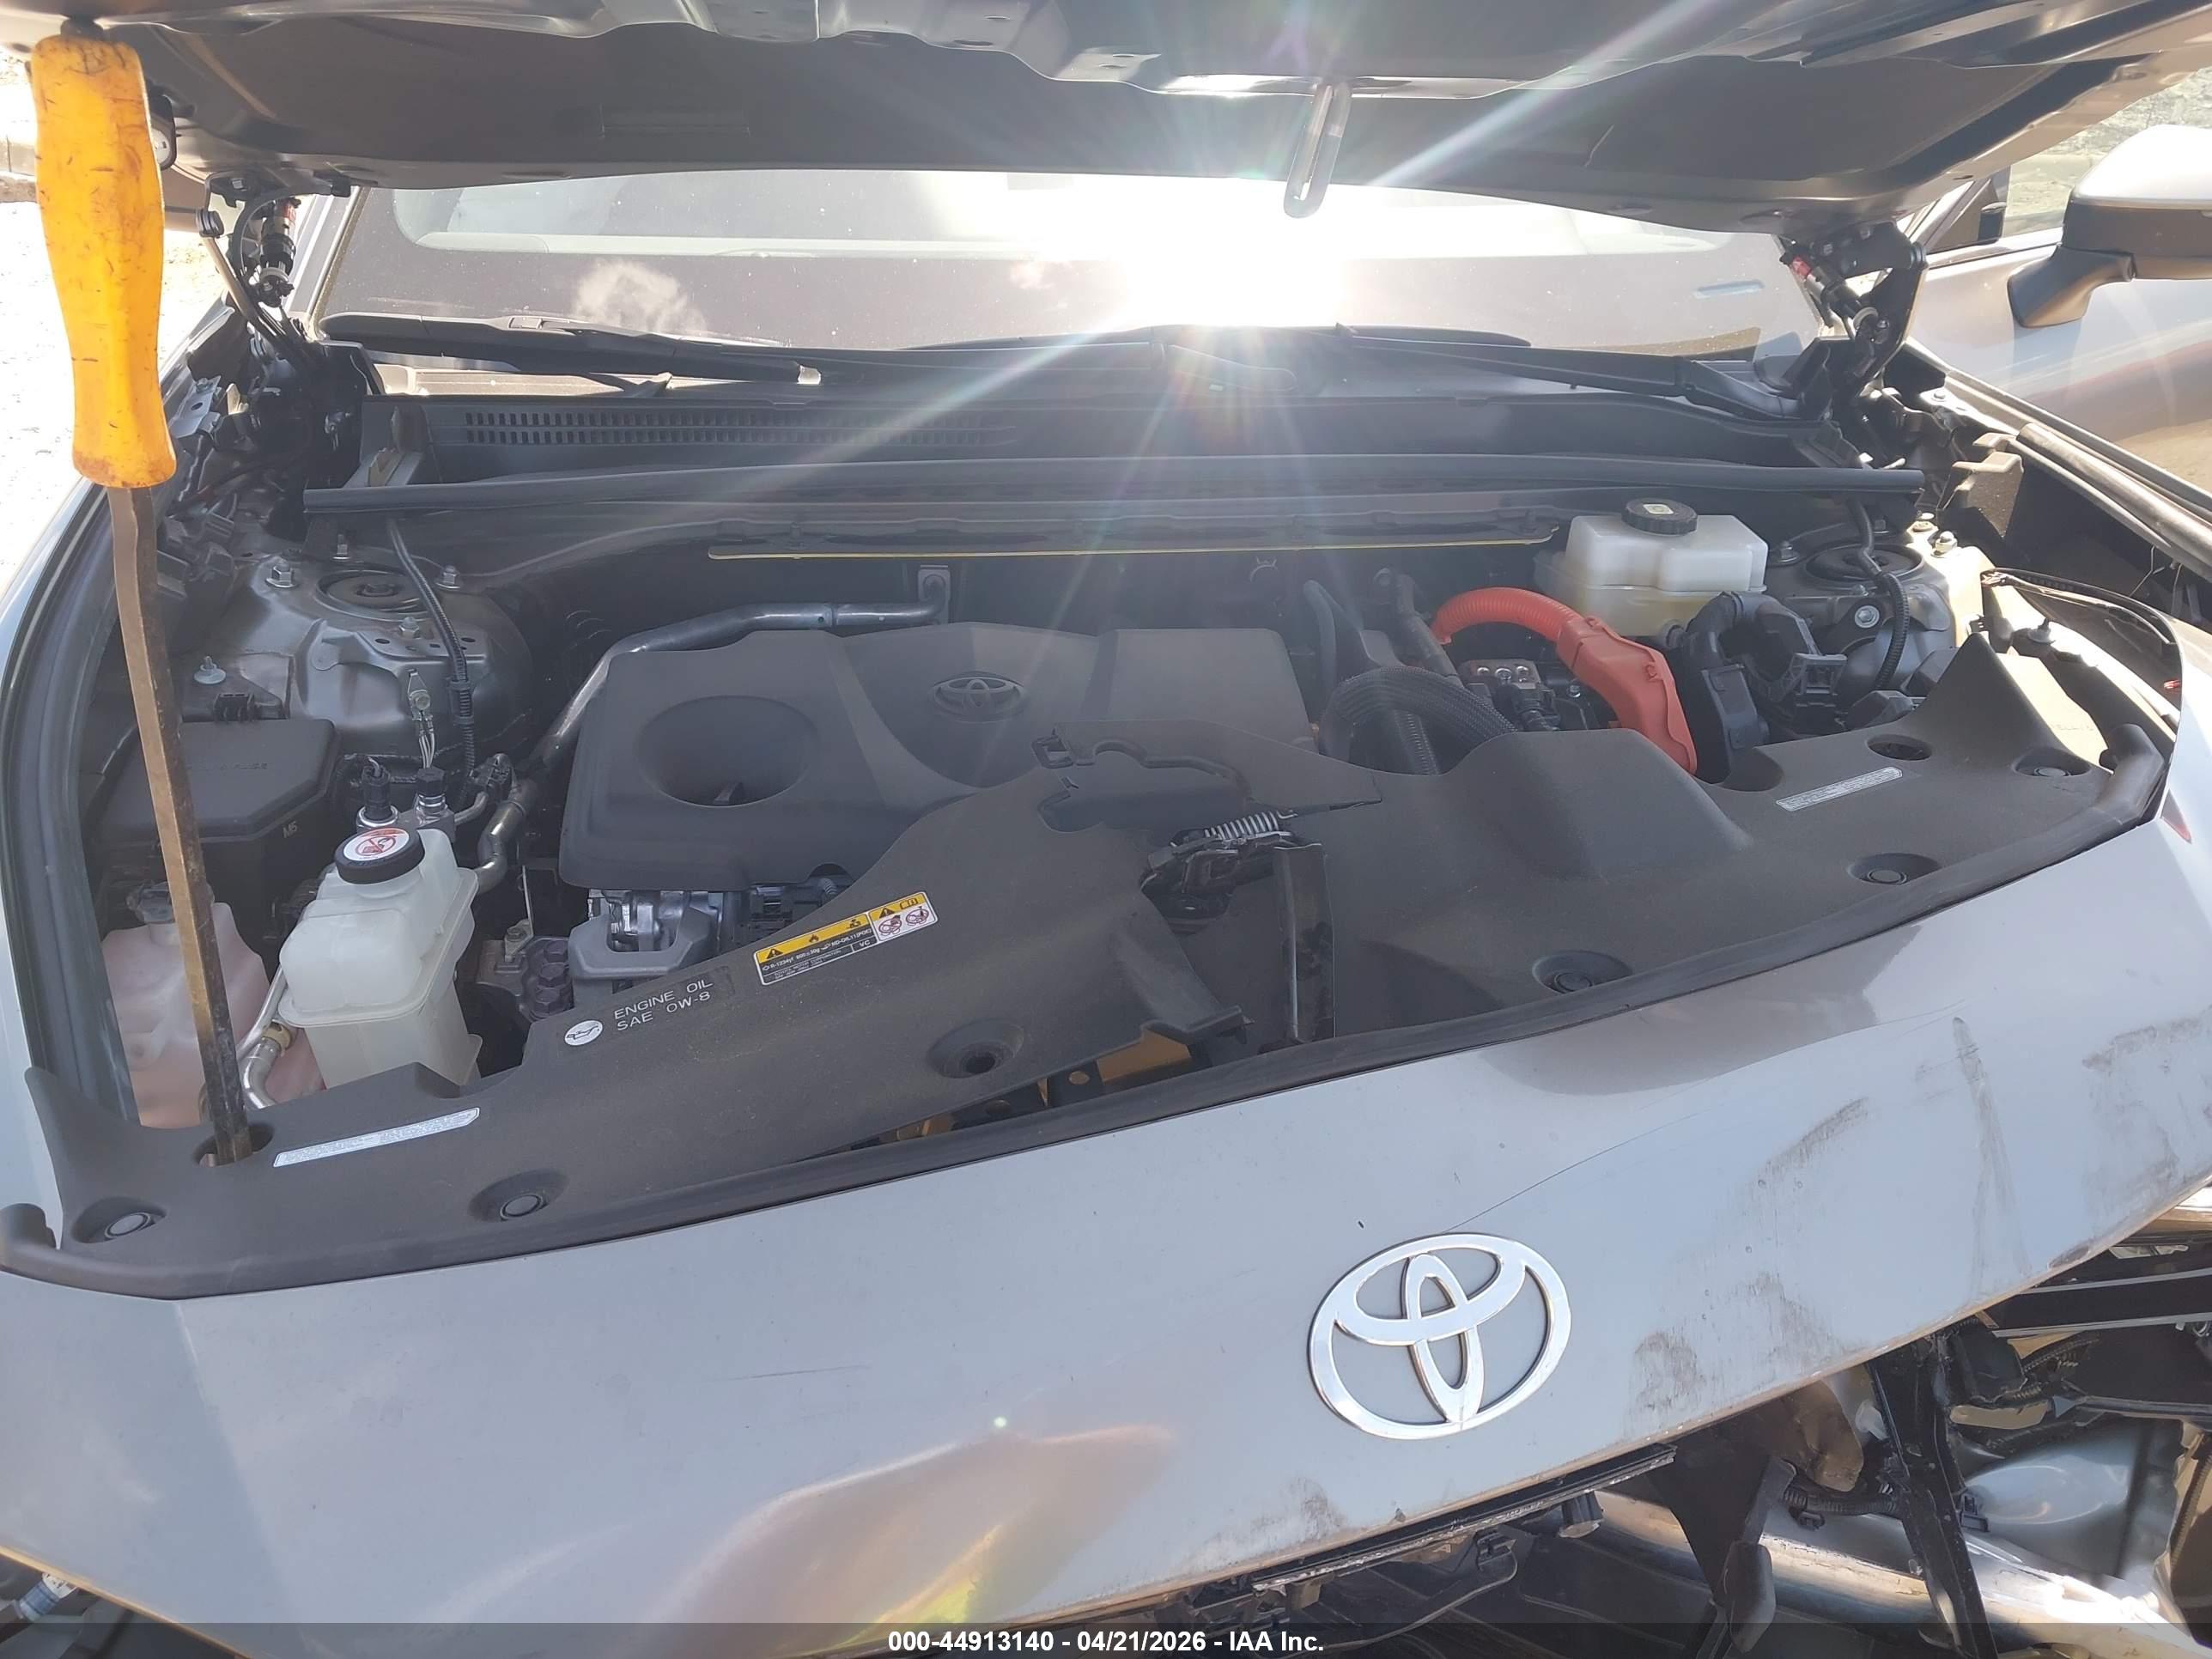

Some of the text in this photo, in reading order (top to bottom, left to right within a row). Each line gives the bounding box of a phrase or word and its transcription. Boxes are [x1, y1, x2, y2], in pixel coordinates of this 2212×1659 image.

[614, 979, 714, 1020] ENGINE OIL
[617, 1011, 653, 1030] SAE
